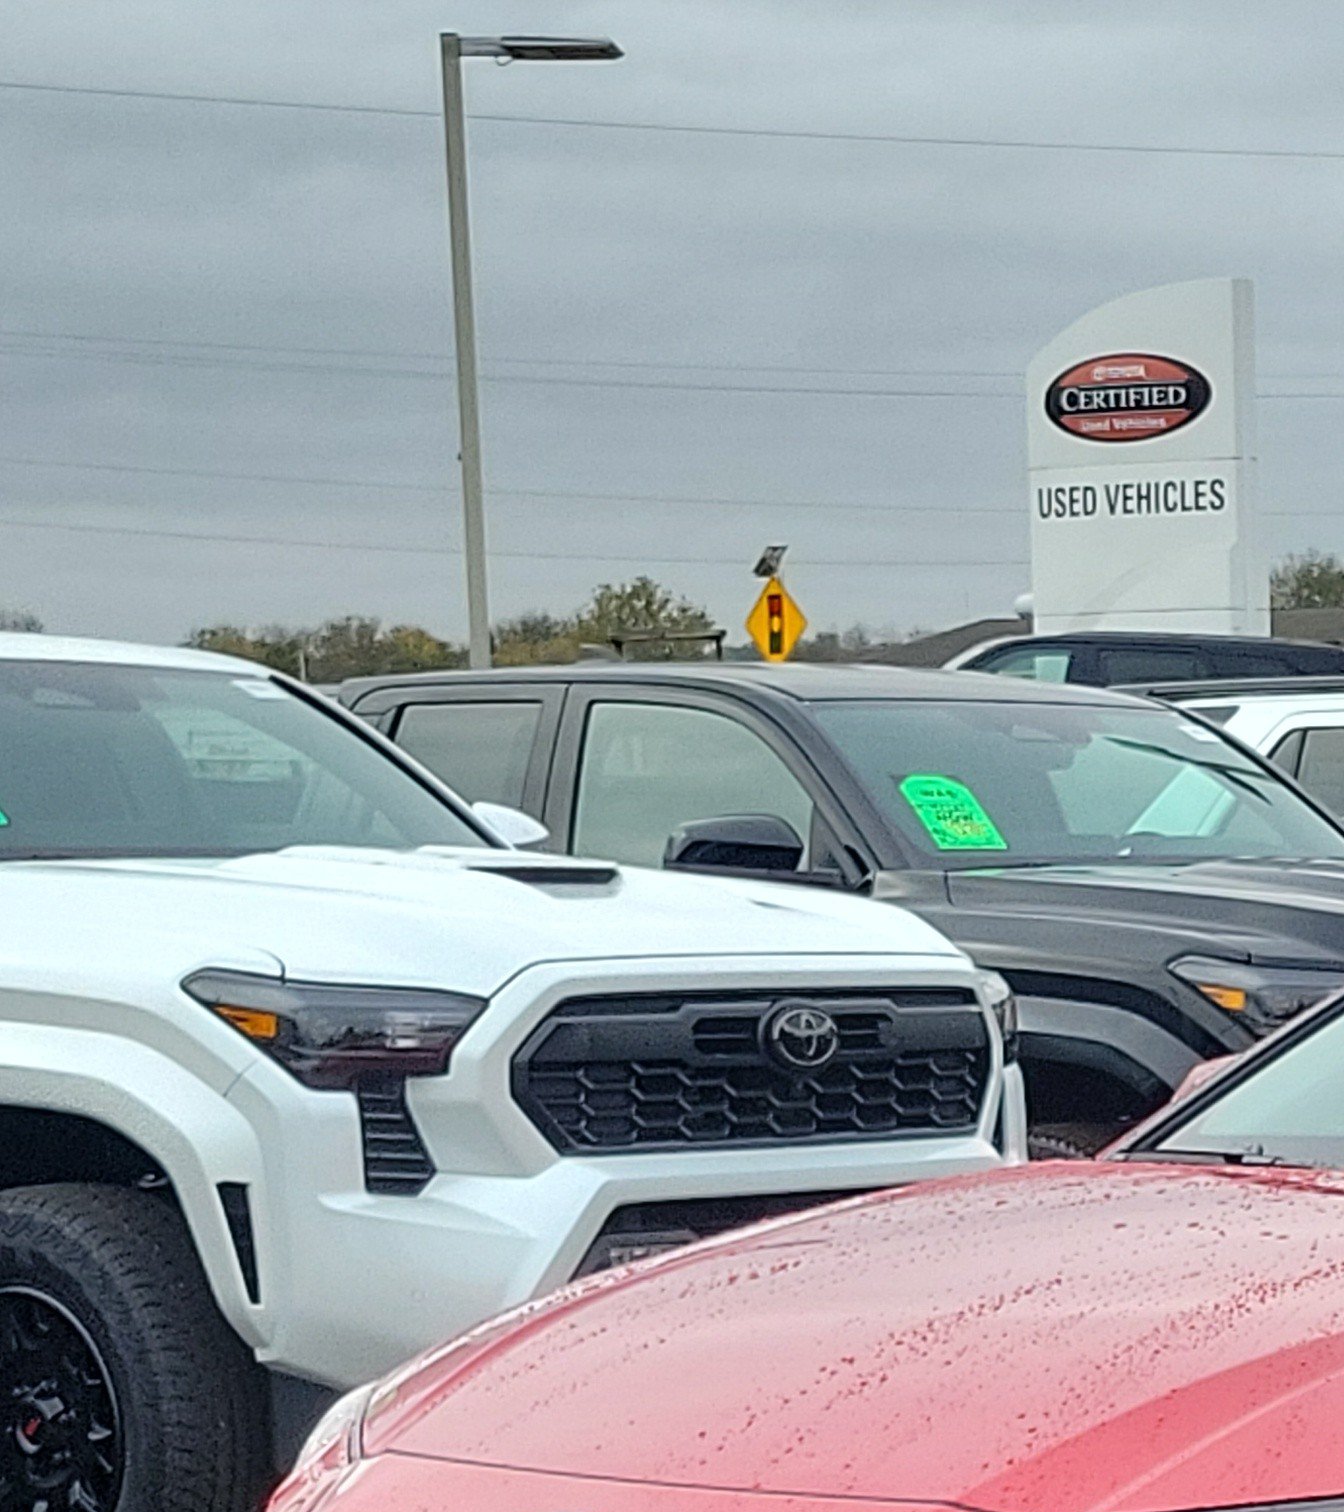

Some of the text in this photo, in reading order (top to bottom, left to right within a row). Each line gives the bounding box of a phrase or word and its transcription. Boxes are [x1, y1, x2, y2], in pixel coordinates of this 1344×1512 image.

[1060, 385, 1187, 412] CERTIFIED
[1038, 478, 1226, 519] USED VEHICLES
